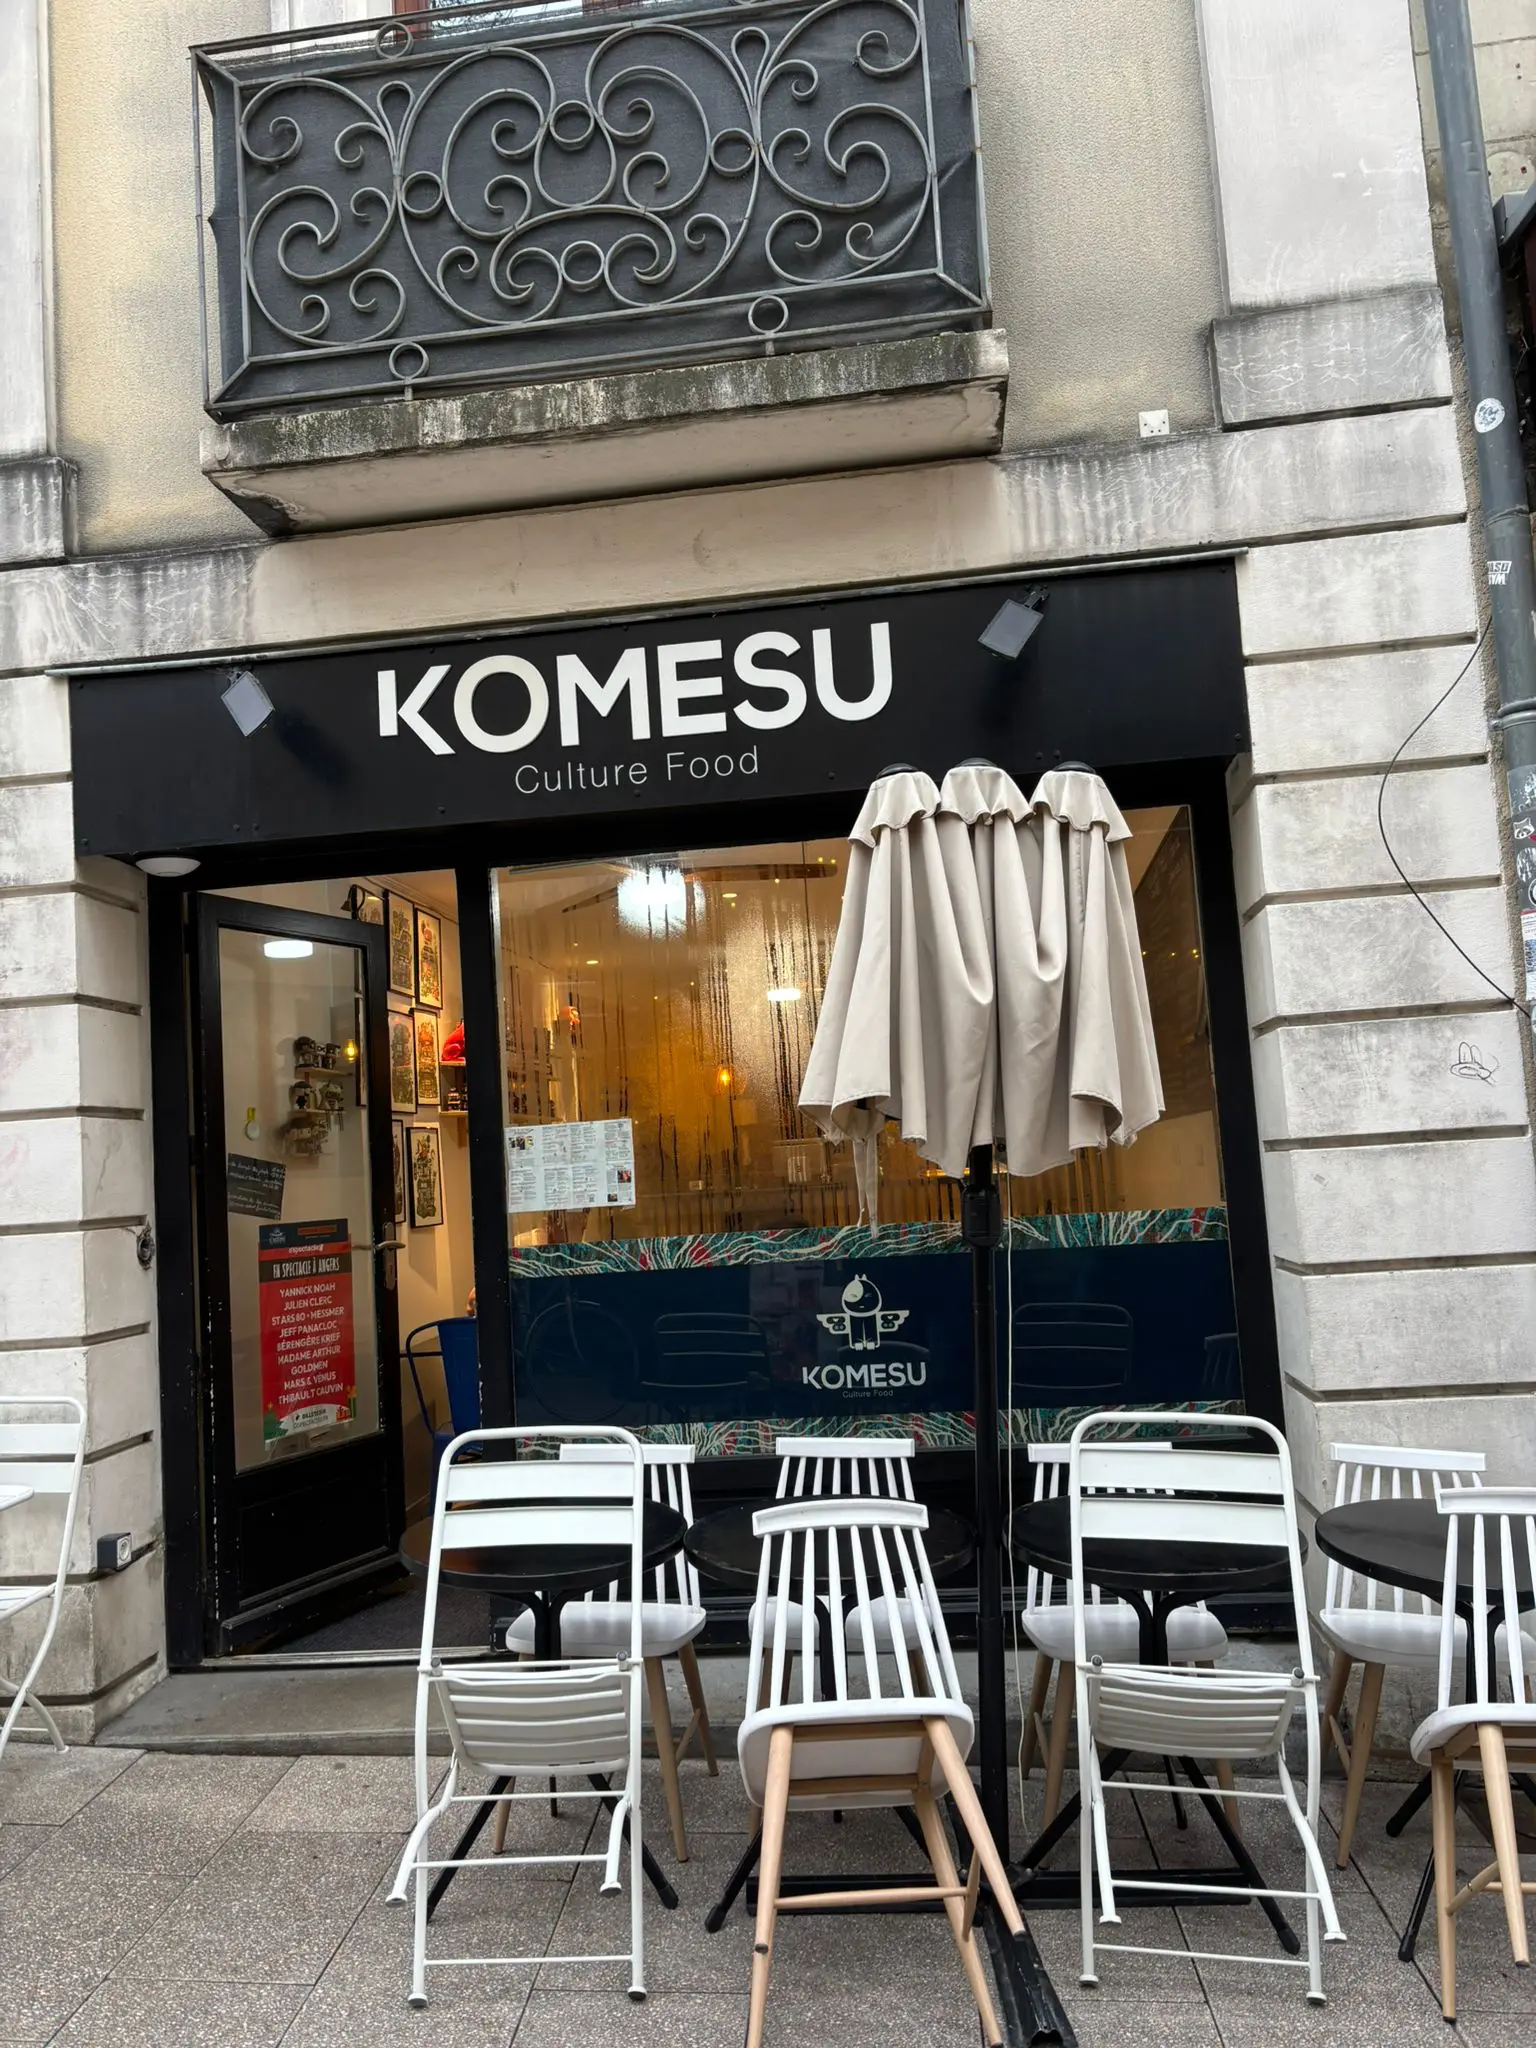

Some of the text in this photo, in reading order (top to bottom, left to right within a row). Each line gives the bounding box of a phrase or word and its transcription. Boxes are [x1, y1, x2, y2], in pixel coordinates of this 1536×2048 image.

[376, 621, 894, 756] KOMESU
[514, 745, 760, 795] Culture Food
[273, 1263, 281, 1279] EN
[282, 1260, 311, 1278] SPECTACLE
[318, 1257, 340, 1273] ANGERS
[280, 1282, 336, 1298] YANNICK NOAH
[284, 1296, 332, 1311] JULIEN CLERC
[272, 1315, 296, 1326] STARS
[310, 1306, 345, 1320] MESSMER
[279, 1320, 337, 1338] JEFF PANACLOC
[277, 1332, 341, 1352] BÉRENGÈRE KRIEF
[278, 1345, 341, 1365] MADAME ARTHUR
[291, 1360, 329, 1375] GOLDMEN
[802, 1362, 927, 1390] KOMESU
[279, 1382, 344, 1404] THIBAULT CAUVIN
[284, 1377, 305, 1390] MARS
[842, 1389, 894, 1398] Culture Food
